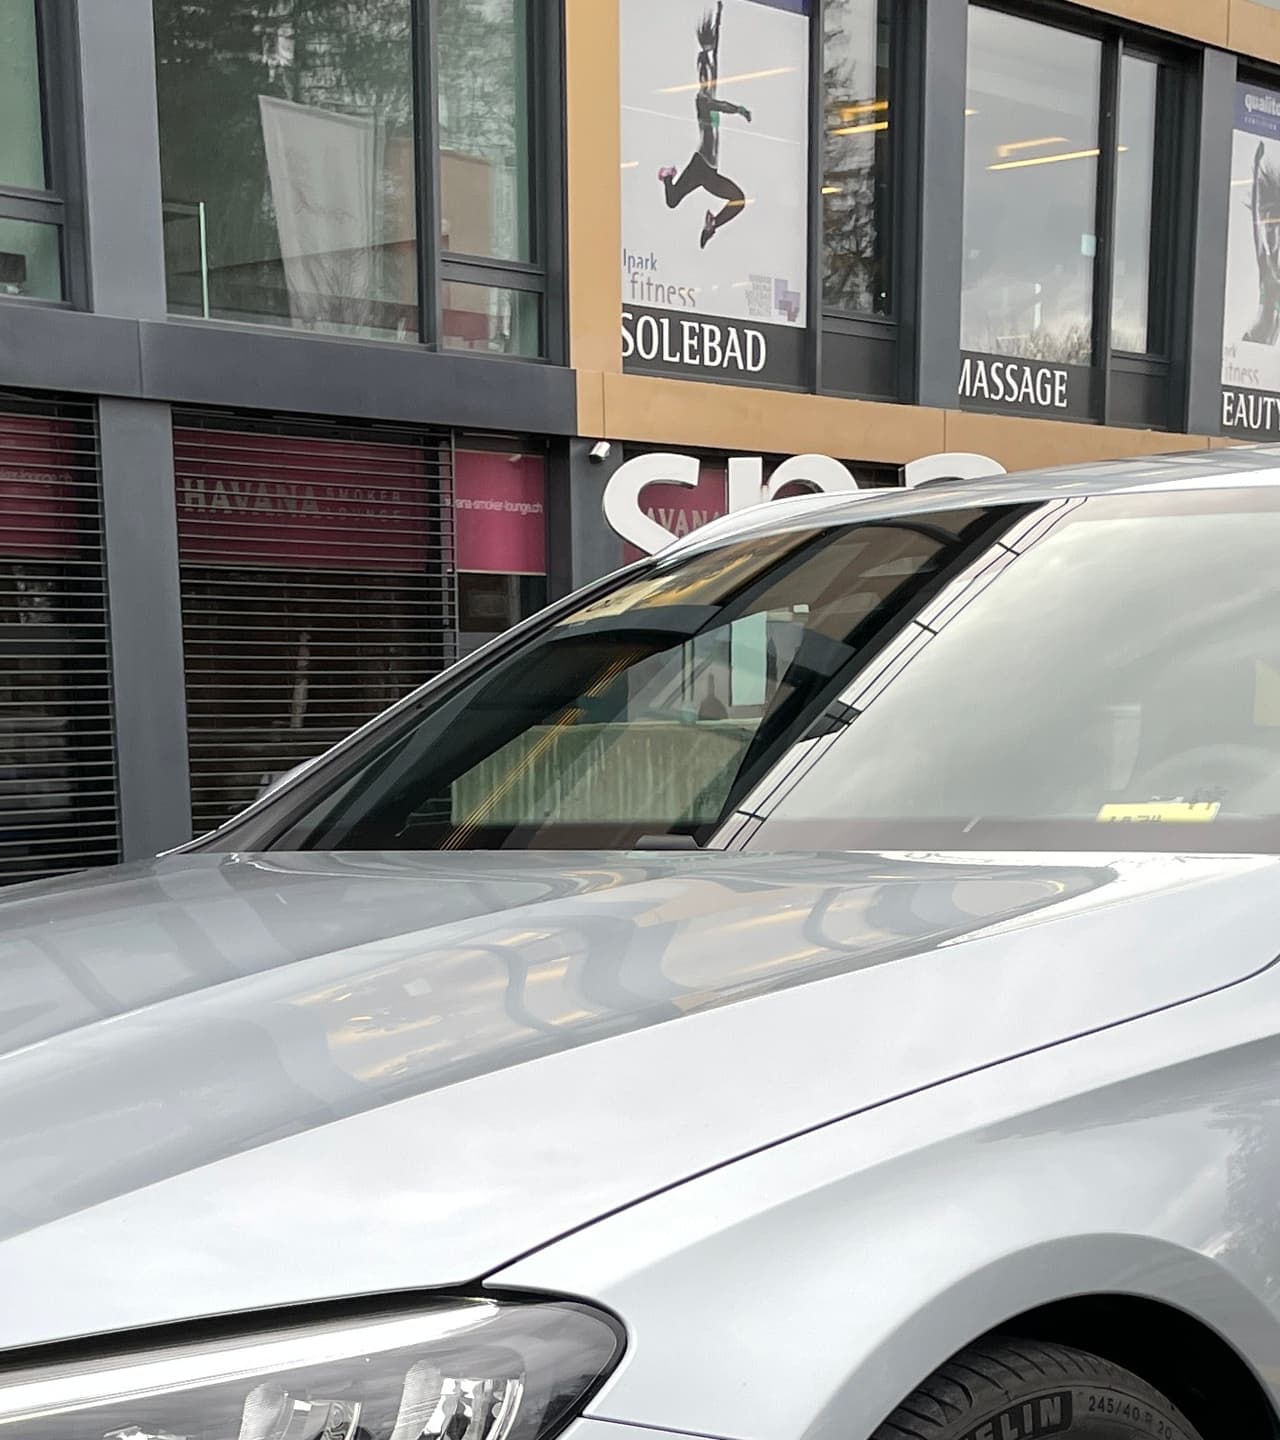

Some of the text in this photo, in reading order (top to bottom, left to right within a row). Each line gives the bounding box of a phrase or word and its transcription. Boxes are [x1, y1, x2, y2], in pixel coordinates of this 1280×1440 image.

[630, 271, 696, 307] fitness
[621, 312, 766, 372] SOLEBAD
[183, 478, 320, 518] HAVANA
[1088, 1395, 1140, 1421] 245/40
